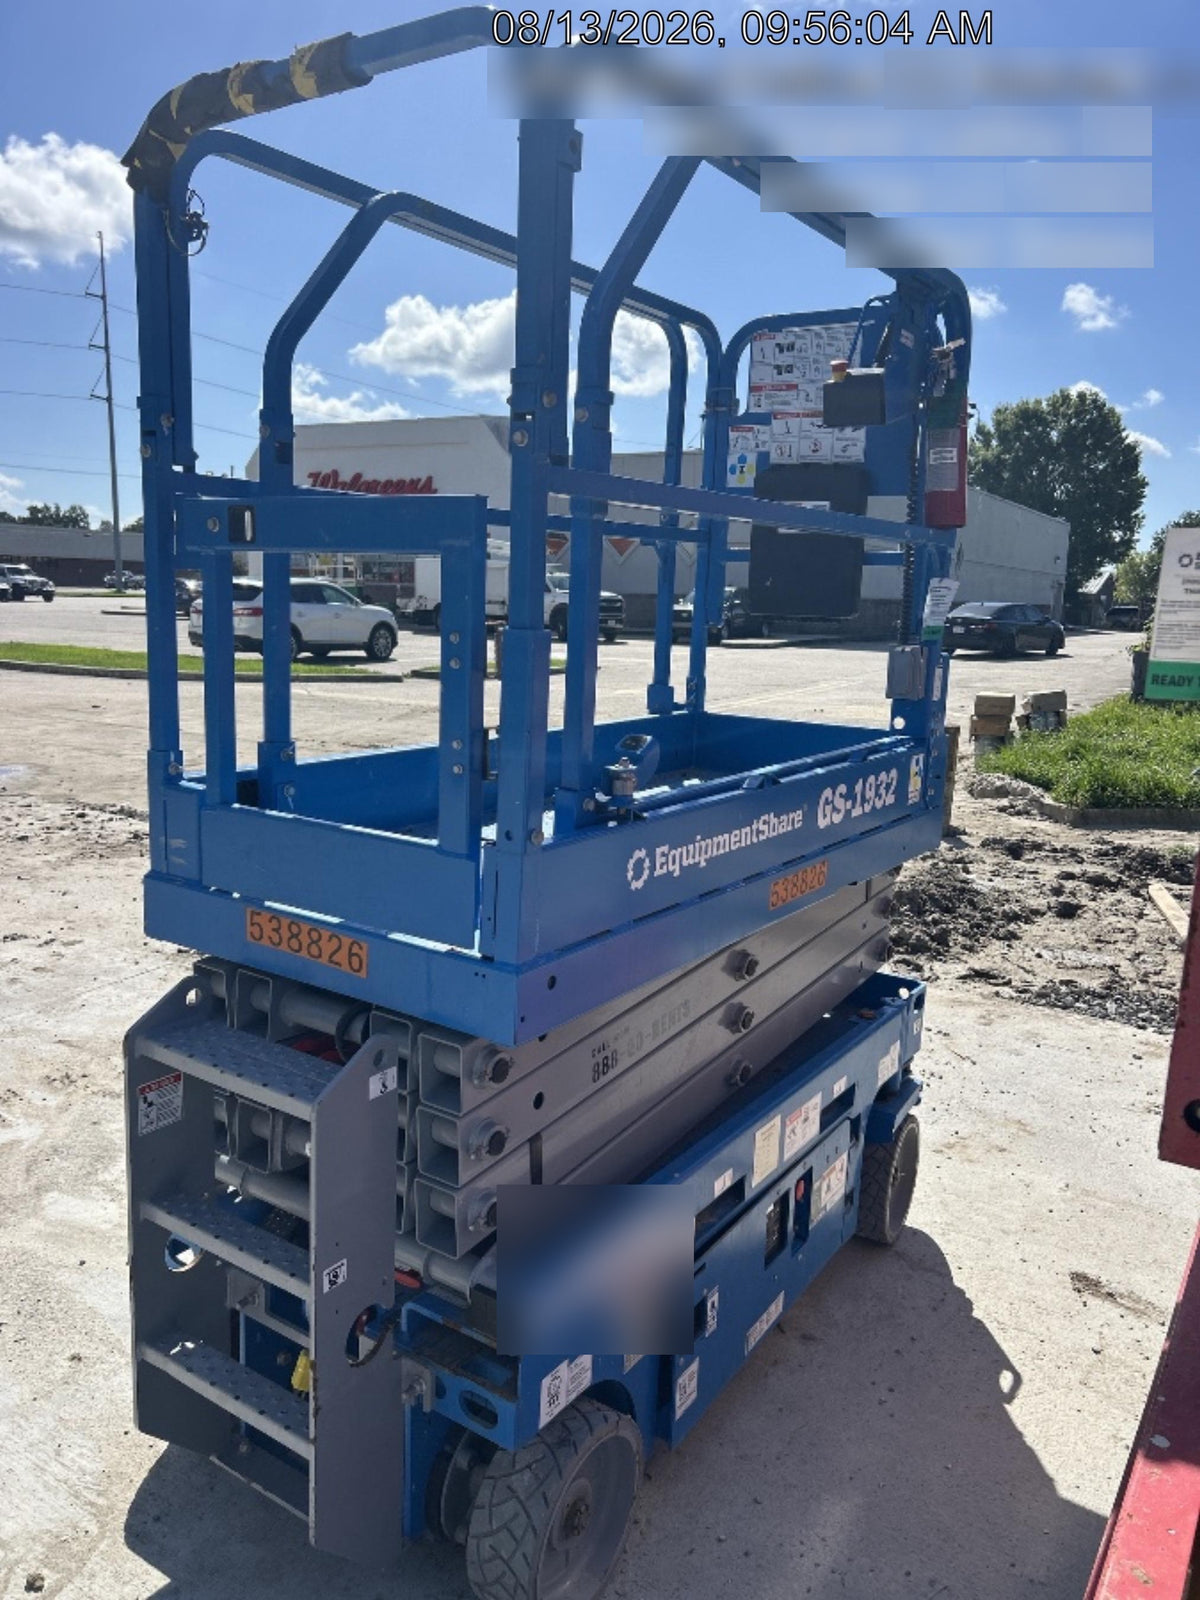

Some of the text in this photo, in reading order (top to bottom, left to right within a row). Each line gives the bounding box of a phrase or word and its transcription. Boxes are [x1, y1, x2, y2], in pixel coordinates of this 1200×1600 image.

[1150, 672, 1195, 688] READY
[817, 767, 898, 830] GS-1932
[653, 806, 804, 879] EquipmentShare
[249, 909, 364, 974] 538826
